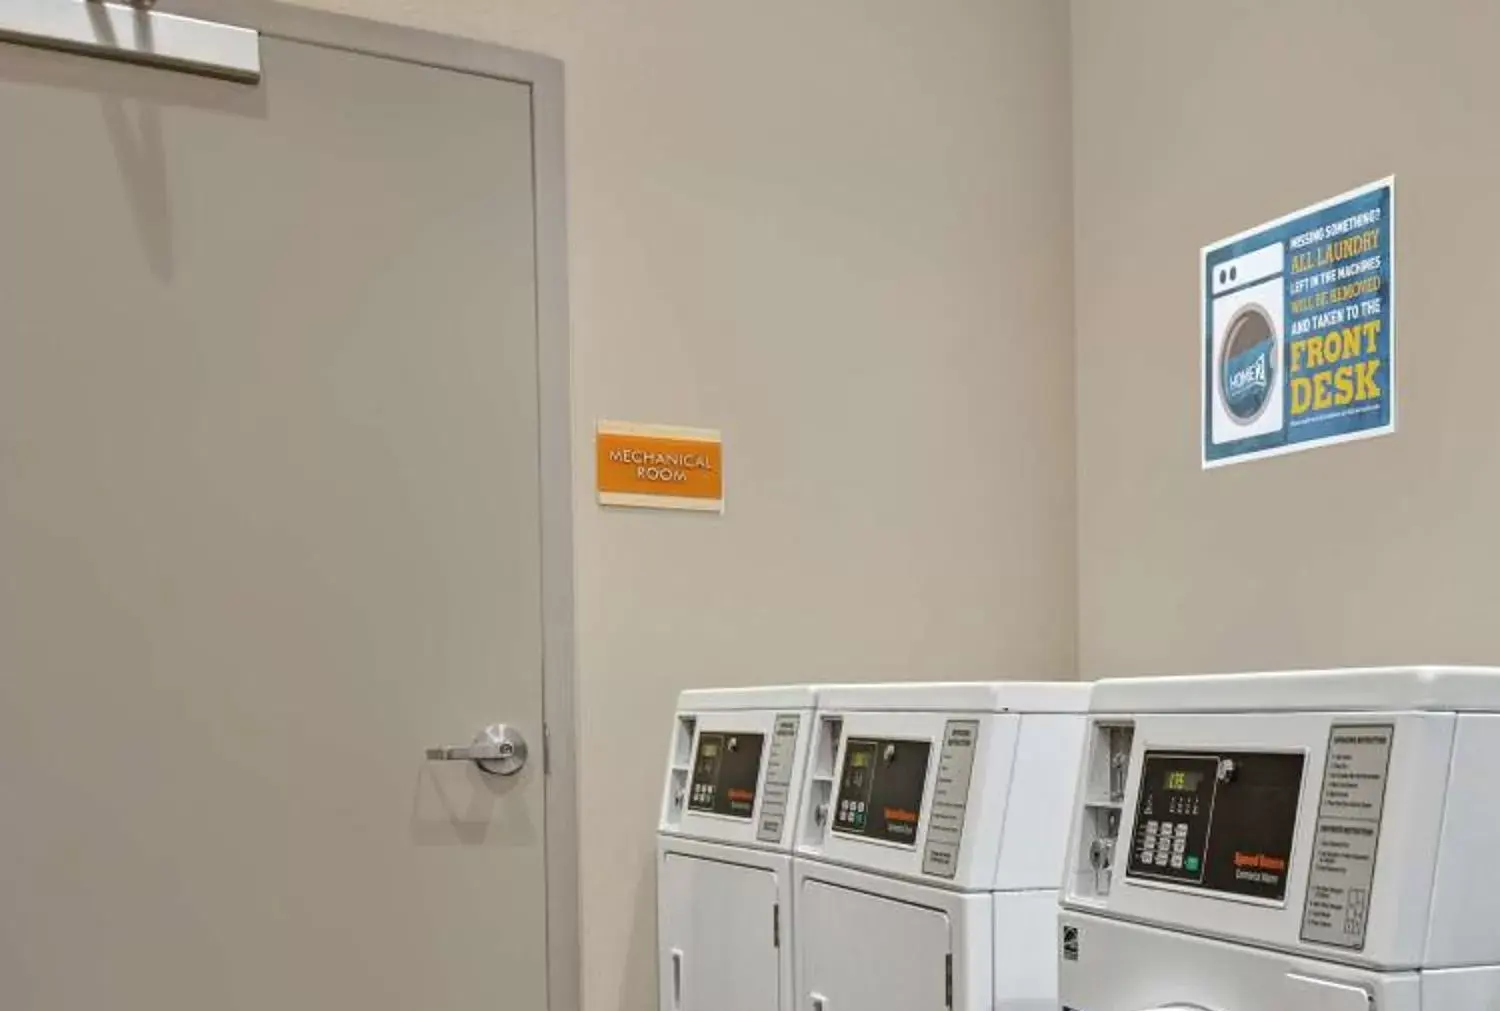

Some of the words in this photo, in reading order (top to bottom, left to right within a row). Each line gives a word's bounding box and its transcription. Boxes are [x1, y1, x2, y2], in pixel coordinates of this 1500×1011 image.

[1317, 228, 1380, 267] LAUNDRY
[1291, 317, 1310, 336] AND
[1312, 306, 1345, 331] TAKEN
[1346, 303, 1359, 320] TO
[1361, 297, 1381, 316] THE
[1290, 319, 1381, 373] FRONT
[1290, 359, 1382, 416] DESK
[609, 448, 711, 470] MECHANICAL
[637, 465, 688, 482] ROOM
